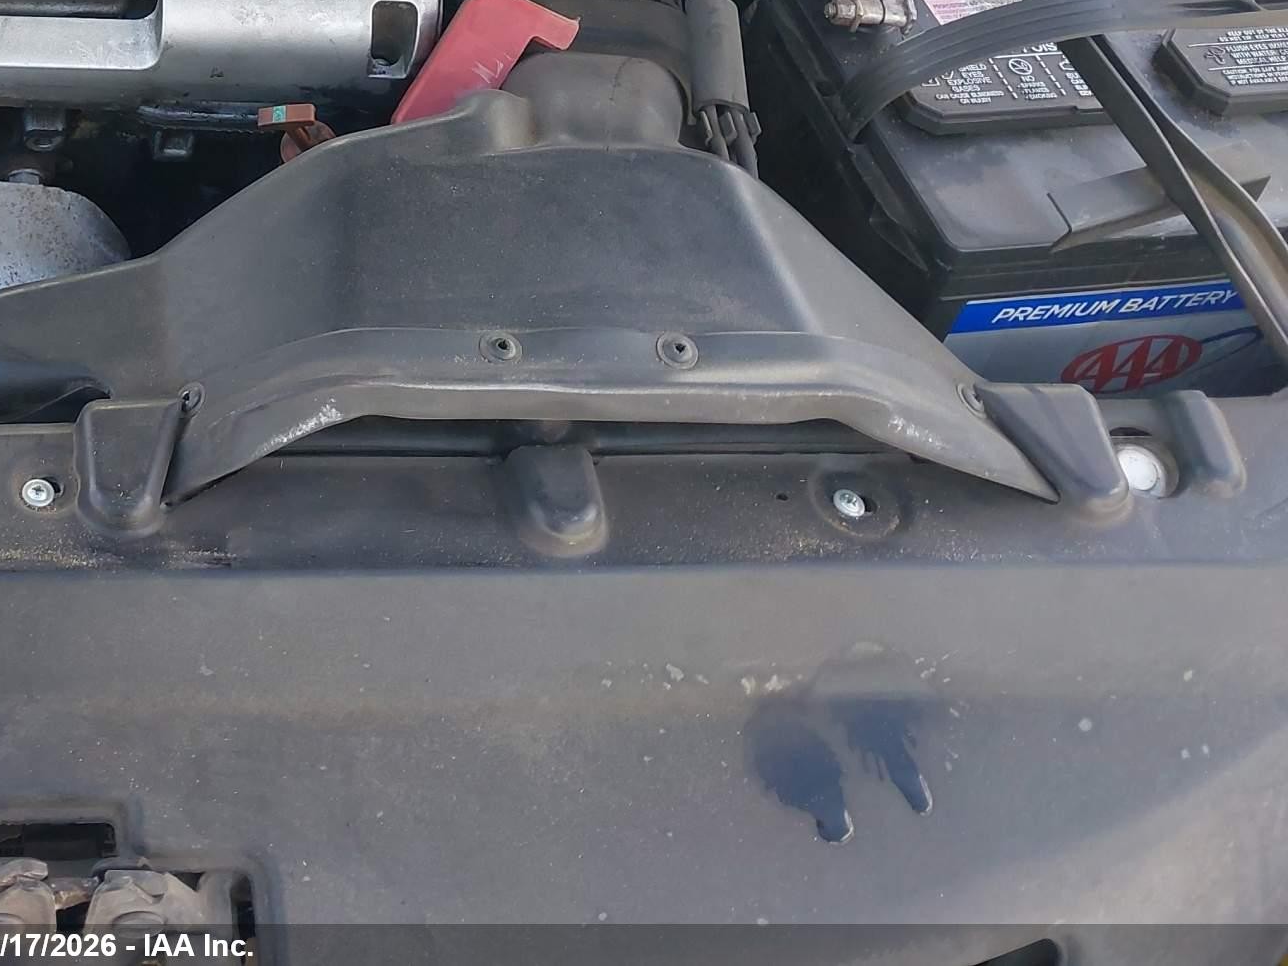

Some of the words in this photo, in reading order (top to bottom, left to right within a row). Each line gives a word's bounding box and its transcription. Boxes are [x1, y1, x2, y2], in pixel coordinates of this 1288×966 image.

[991, 298, 1123, 324] PREMIUM
[1119, 289, 1239, 314] BATTERY
[1061, 334, 1203, 394] AAA
